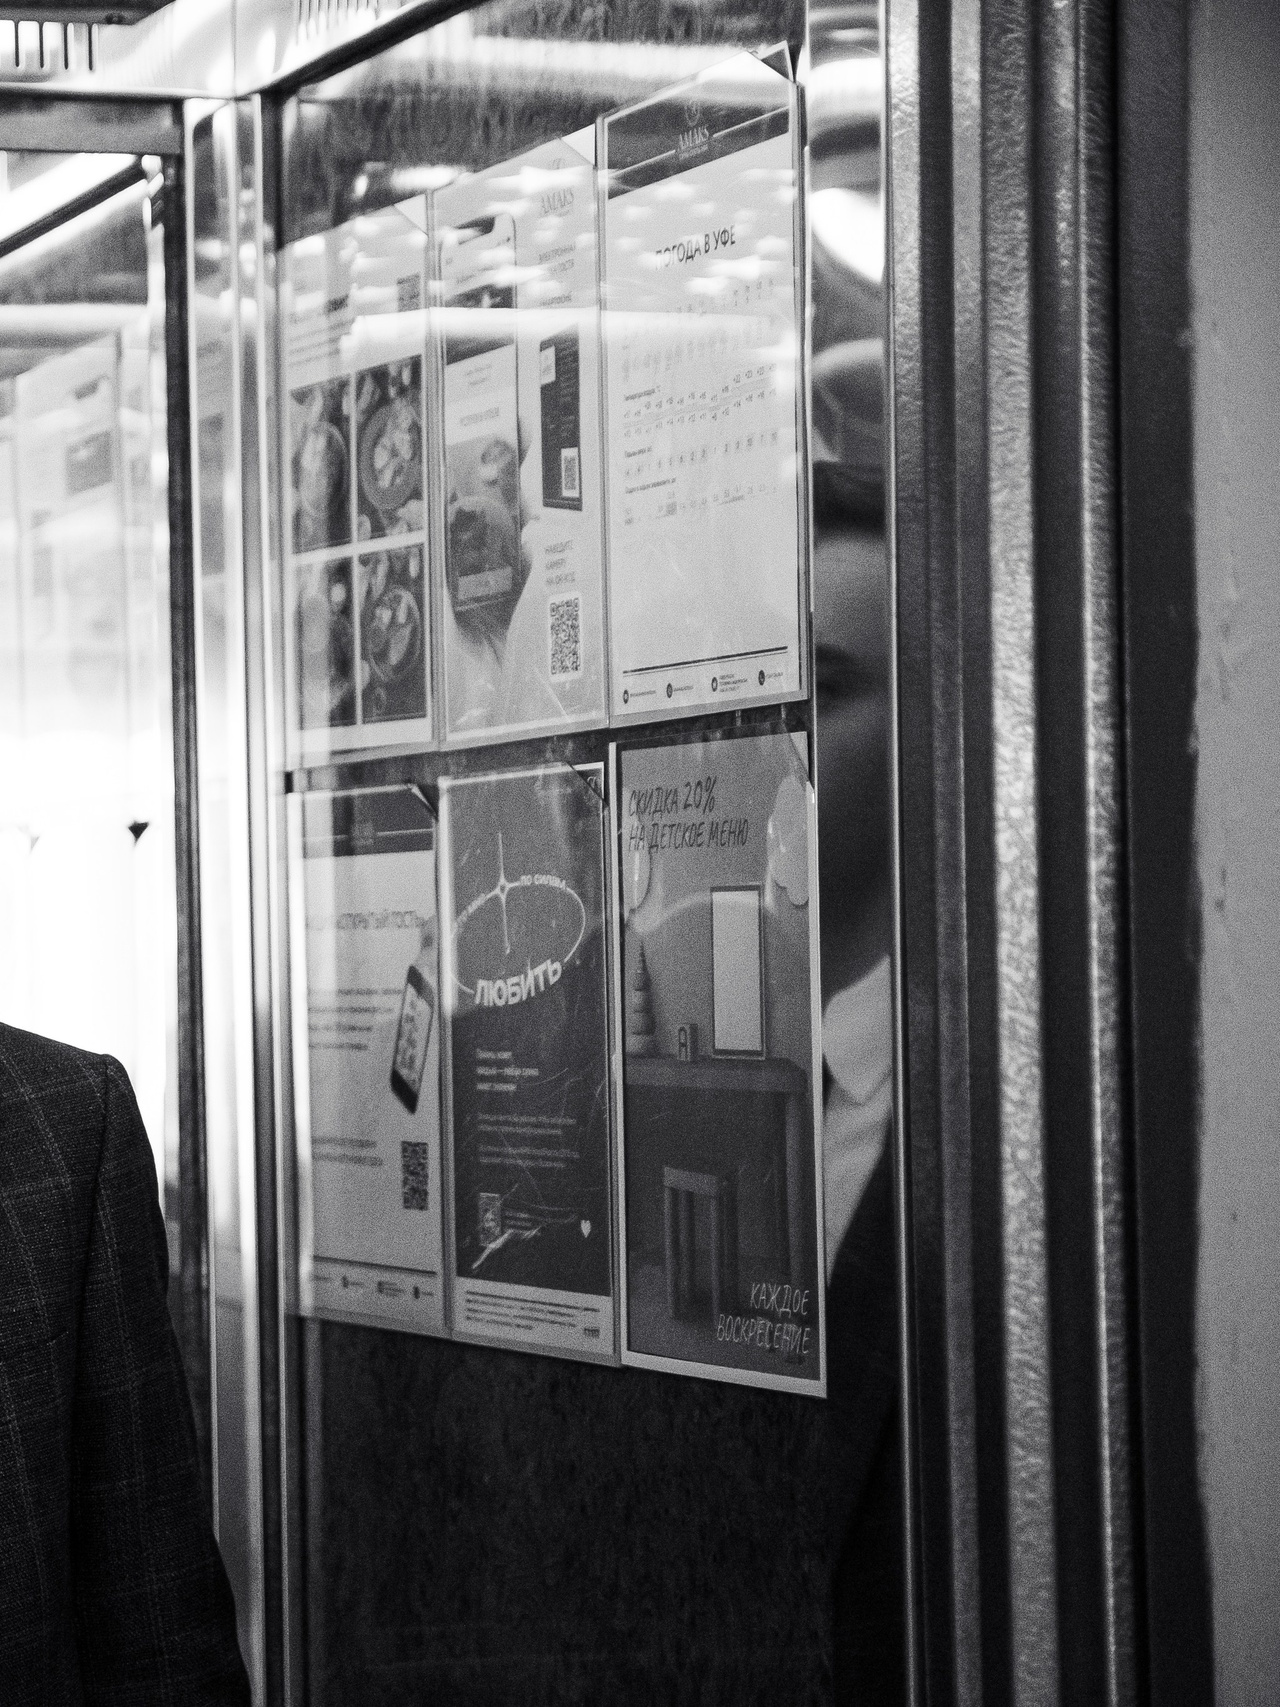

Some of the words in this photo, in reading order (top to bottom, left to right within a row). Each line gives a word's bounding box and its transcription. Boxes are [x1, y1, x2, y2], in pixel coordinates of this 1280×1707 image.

[656, 239, 701, 270] ПОГОДА
[704, 233, 710, 254] В
[713, 225, 736, 251] УФЕ
[629, 787, 679, 819] СКИДКА
[684, 775, 717, 814] 20%
[629, 823, 645, 851] НА
[648, 821, 705, 854] ДЕТСКОЕ
[708, 818, 749, 847] МЕНЮ
[475, 959, 562, 1006] ЛЮБИТЬ
[750, 1282, 810, 1319] КАЖДОЕ
[716, 1314, 810, 1354] ВОСКРЕСЕНИЕ
